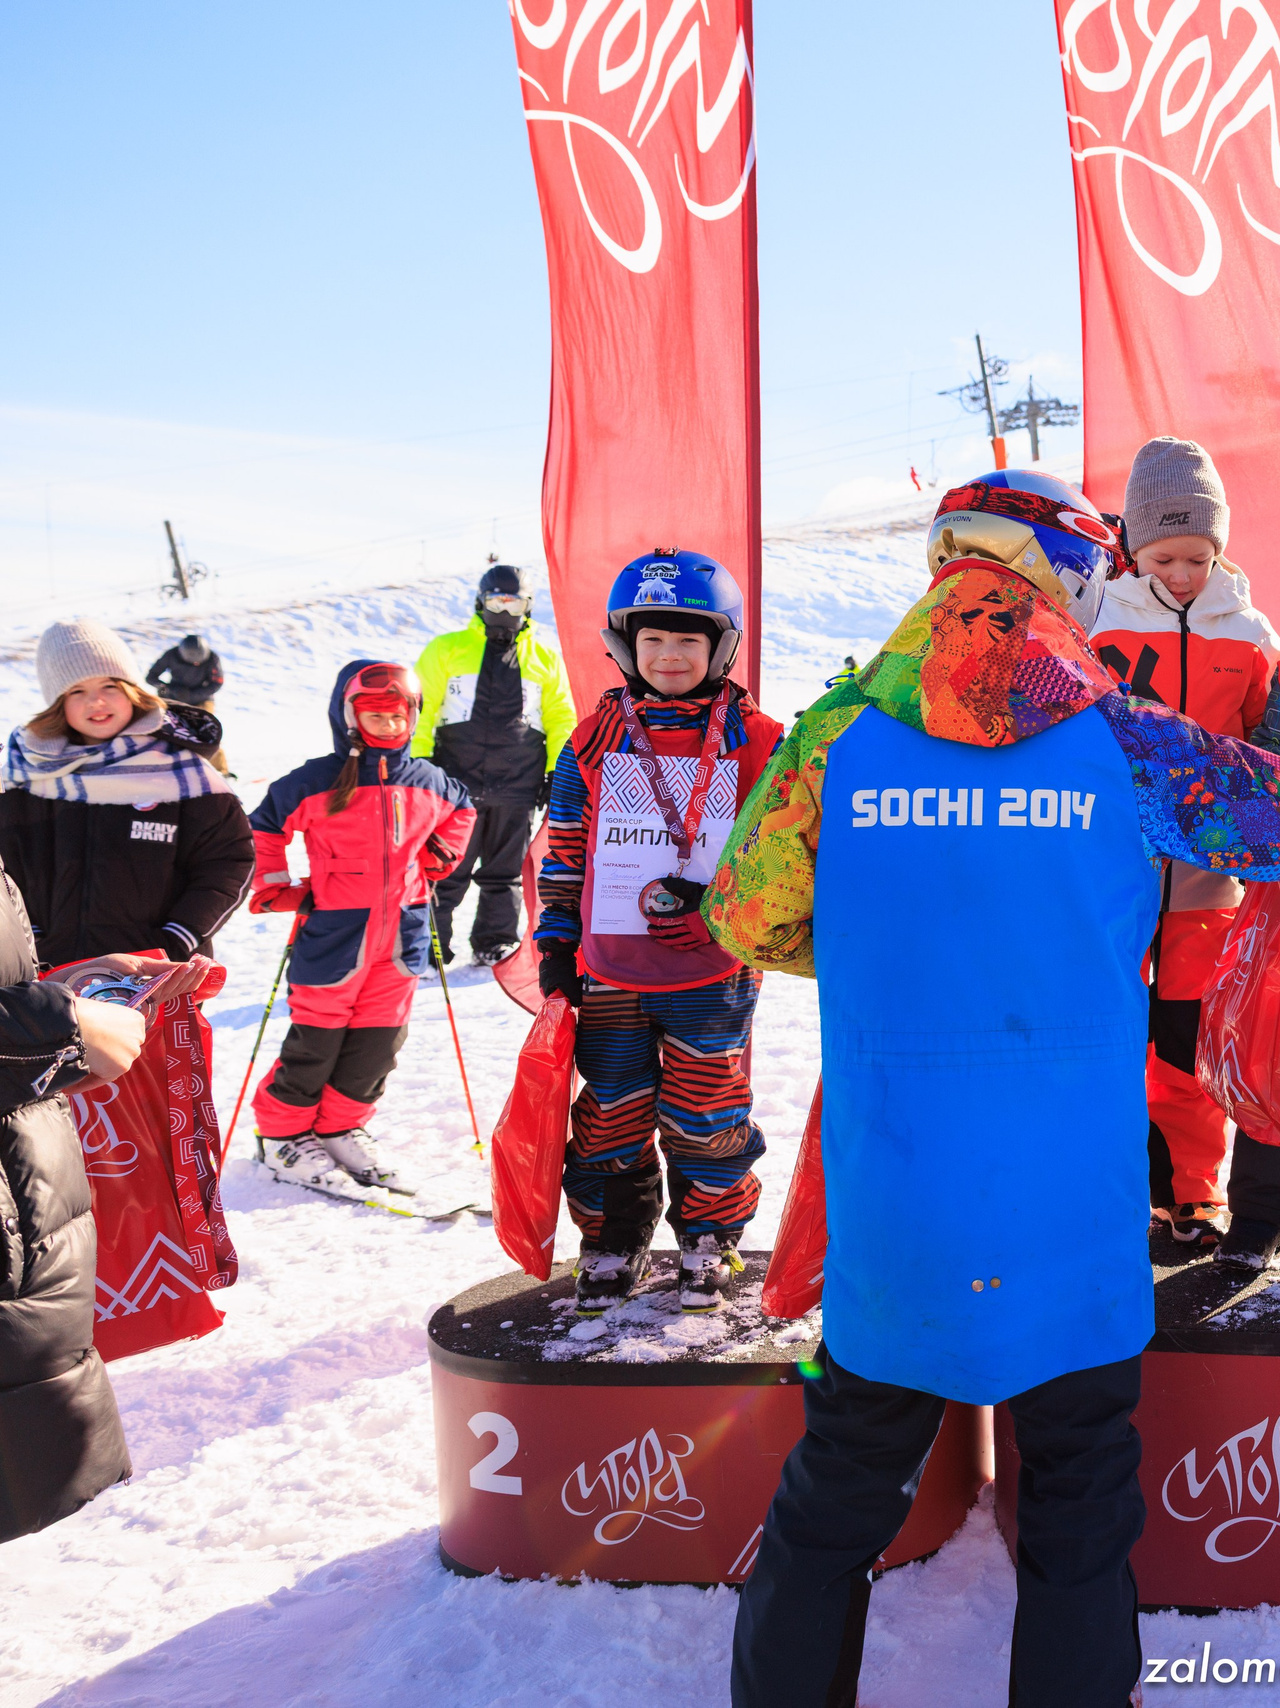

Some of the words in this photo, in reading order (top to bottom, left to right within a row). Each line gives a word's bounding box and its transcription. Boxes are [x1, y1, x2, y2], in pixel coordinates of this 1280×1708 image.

[1158, 511, 1191, 527] NIKE
[644, 571, 675, 579] SEASON
[851, 788, 984, 828] SOCHI
[998, 788, 1097, 830] 2014
[130, 820, 178, 843] DKNY
[604, 826, 706, 848] ДИПЛМ
[467, 1411, 523, 1496] 2
